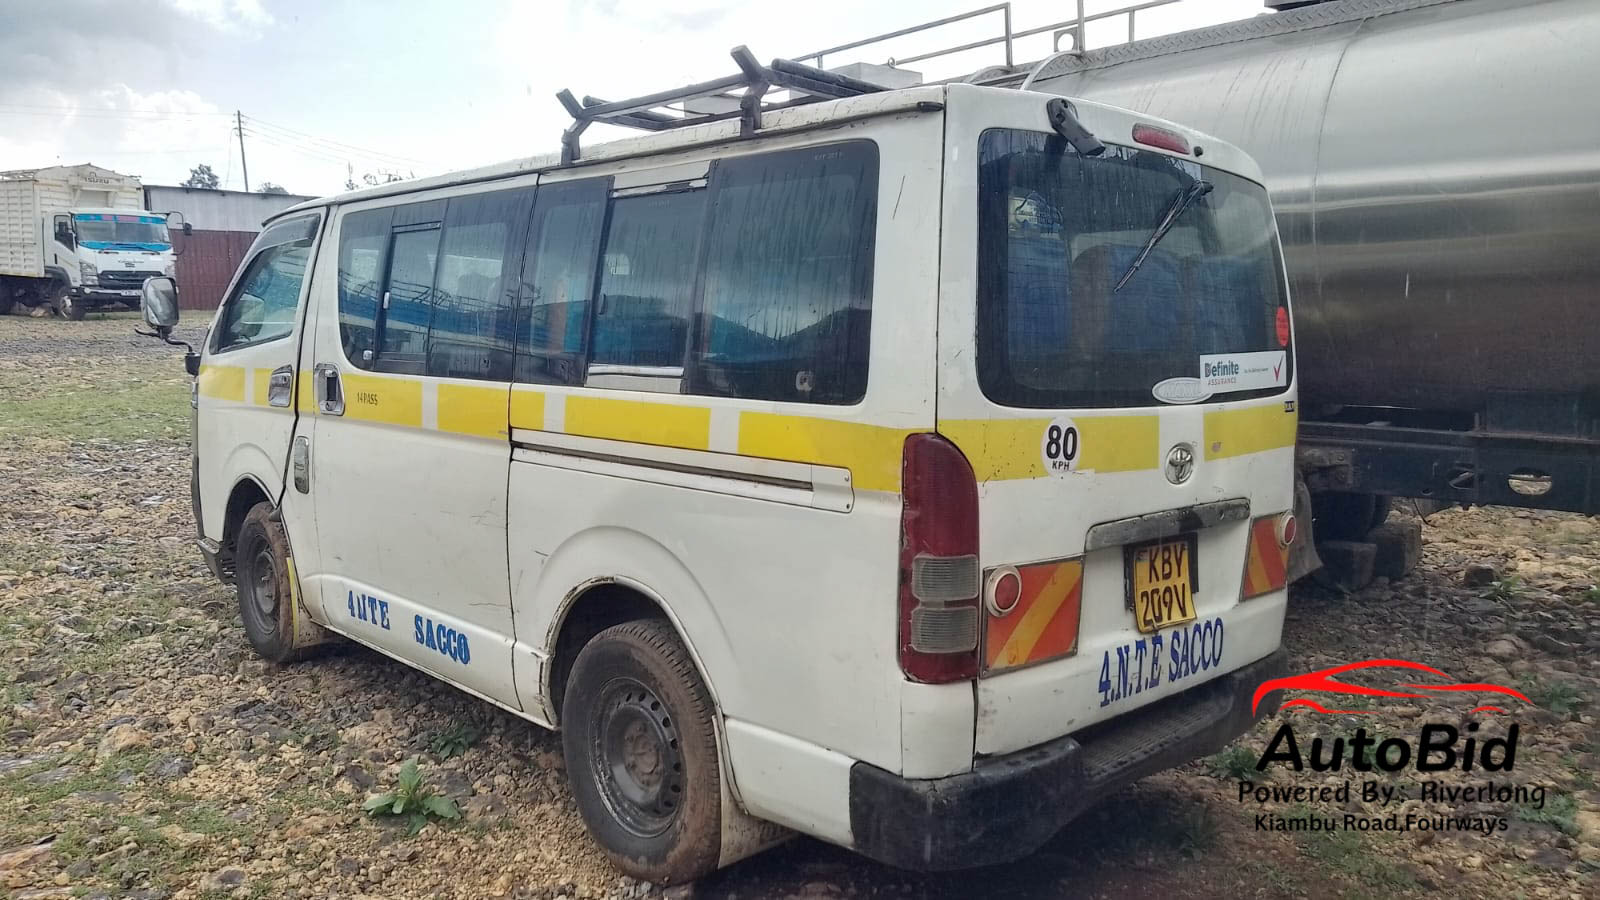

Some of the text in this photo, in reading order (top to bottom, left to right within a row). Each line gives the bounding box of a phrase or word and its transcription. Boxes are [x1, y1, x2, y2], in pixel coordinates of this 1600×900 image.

[1204, 360, 1240, 378] Definite
[1046, 424, 1078, 461] 80
[1052, 460, 1070, 471] KPH
[1148, 542, 1186, 584] KBY
[1140, 583, 1188, 627] 209V
[414, 614, 471, 665] SACCO
[1168, 616, 1224, 683] SACCO
